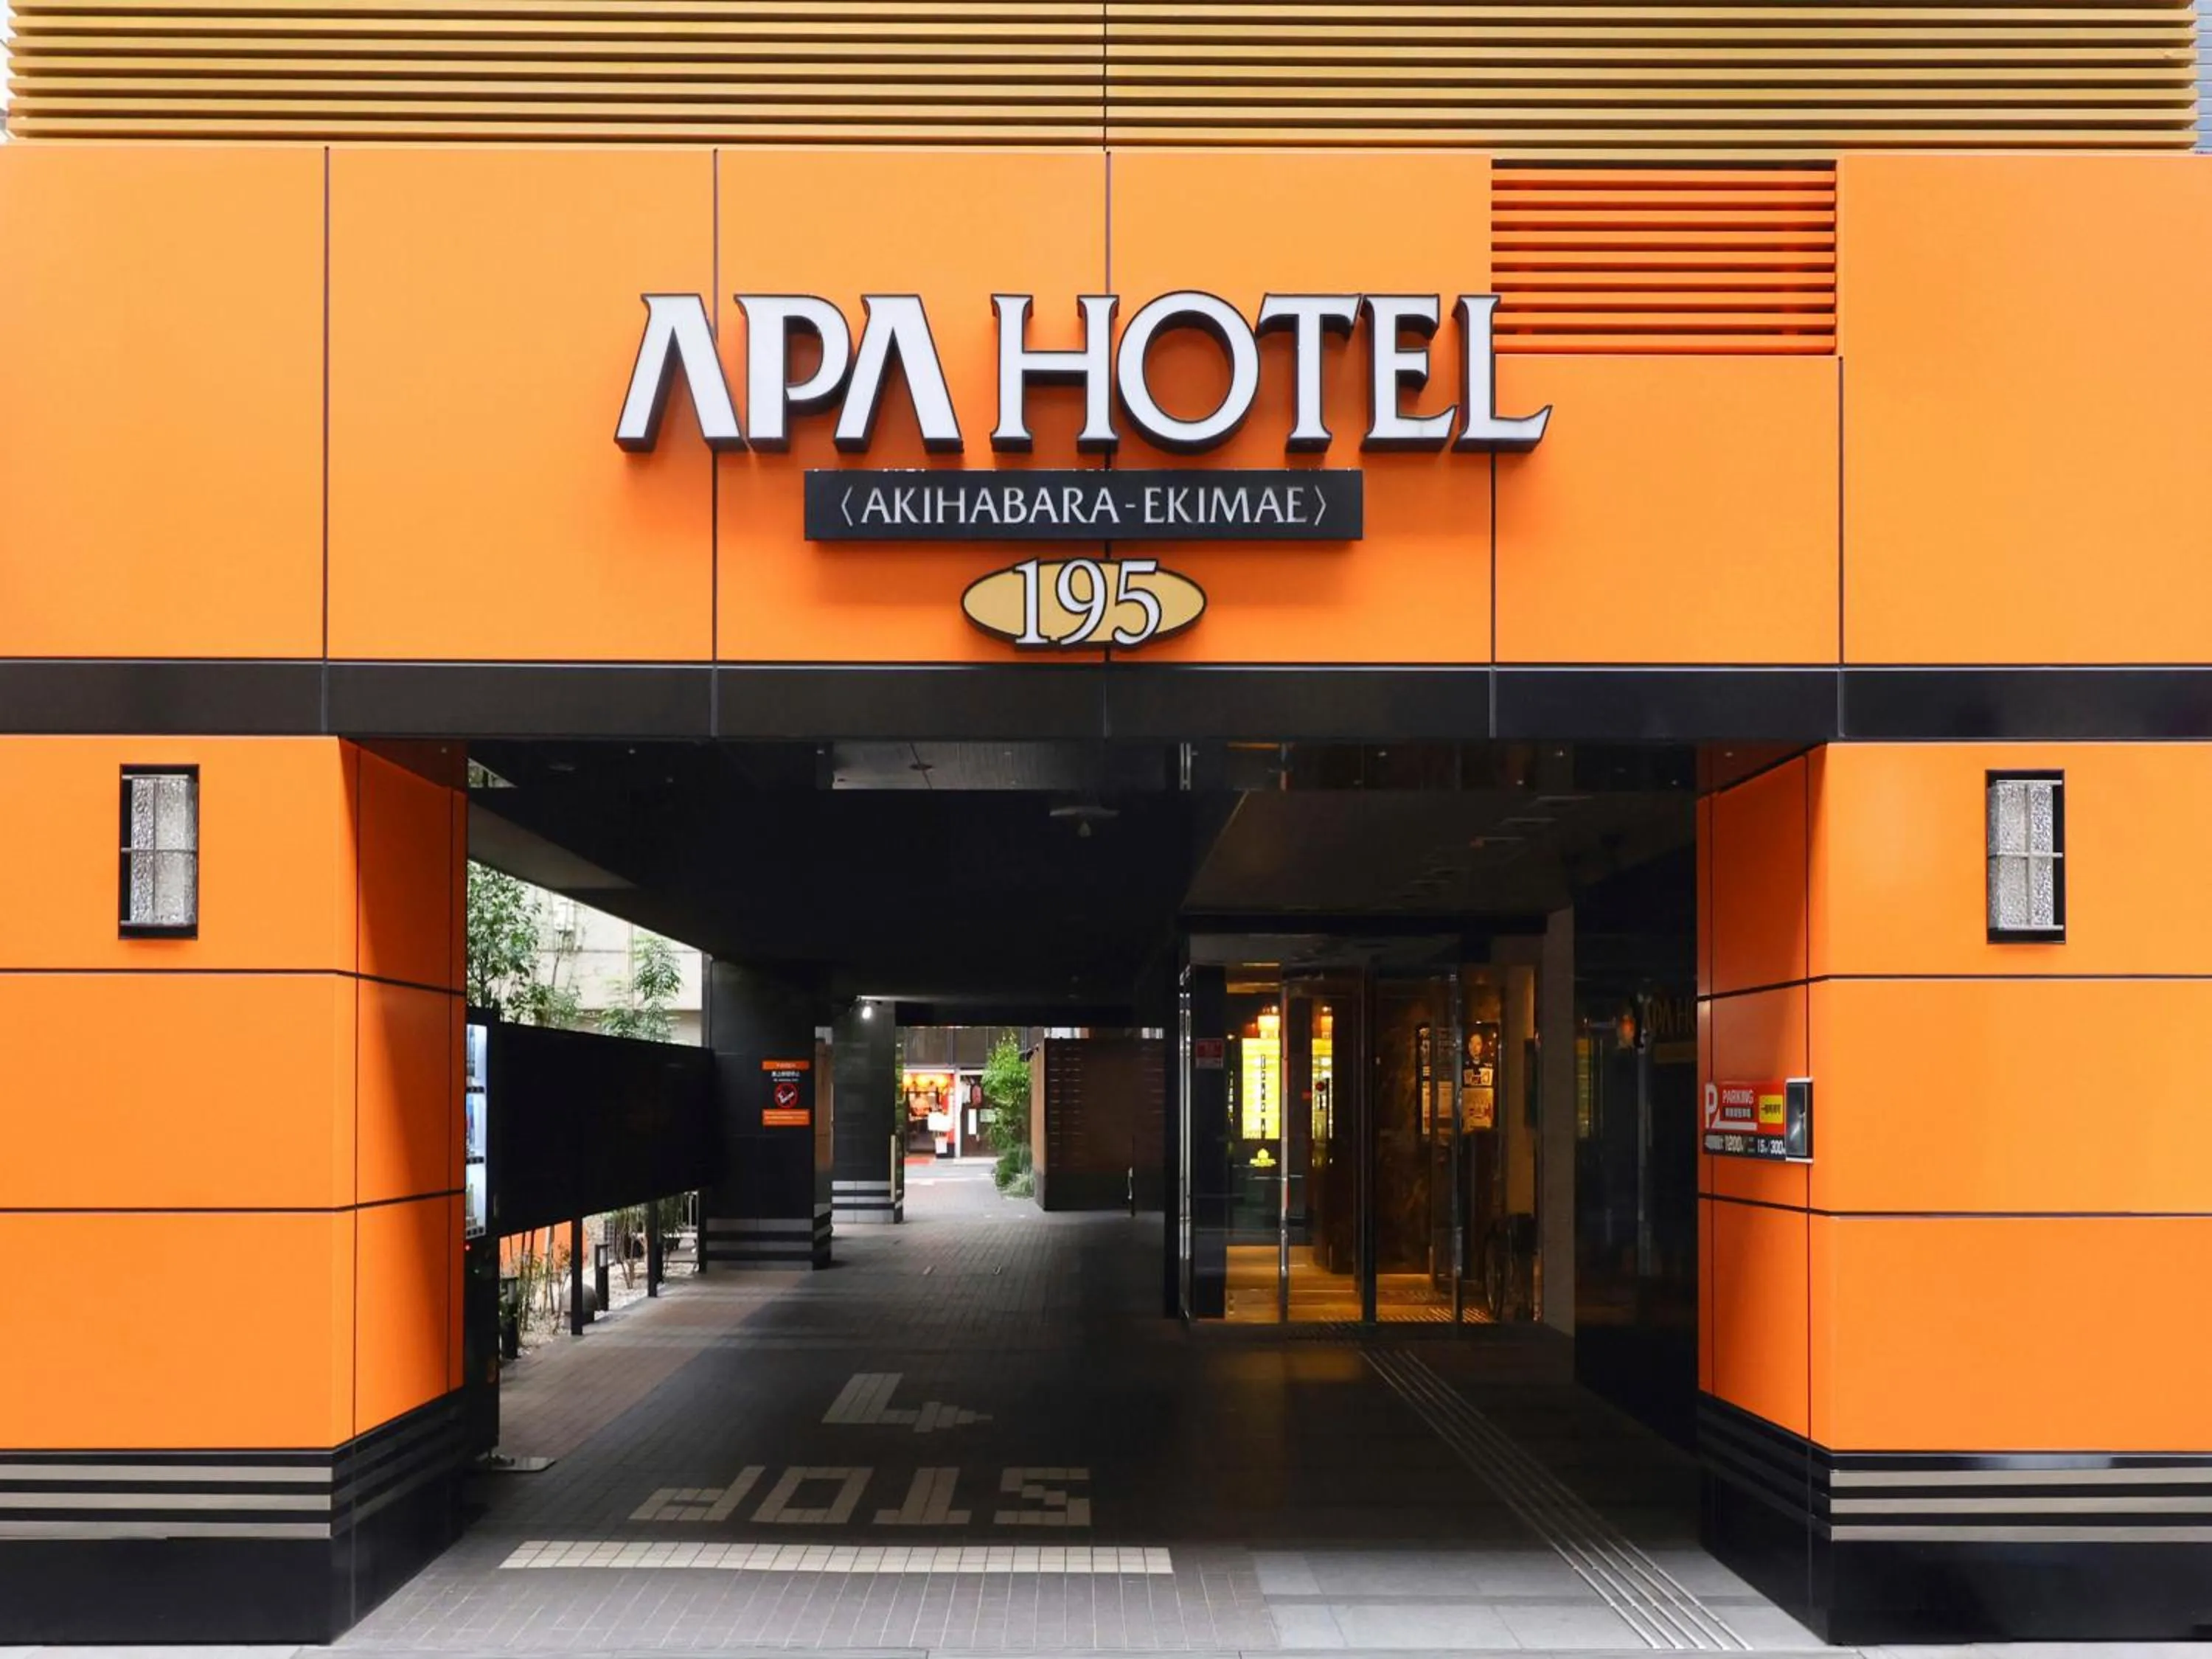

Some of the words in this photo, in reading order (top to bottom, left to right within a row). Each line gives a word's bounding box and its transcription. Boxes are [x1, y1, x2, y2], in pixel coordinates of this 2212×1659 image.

[614, 293, 964, 451] APA
[991, 291, 1552, 453] HOTEL
[1013, 558, 1163, 647] 195
[1722, 1089, 1754, 1104] PARKING
[629, 1465, 1091, 1526] STOP
